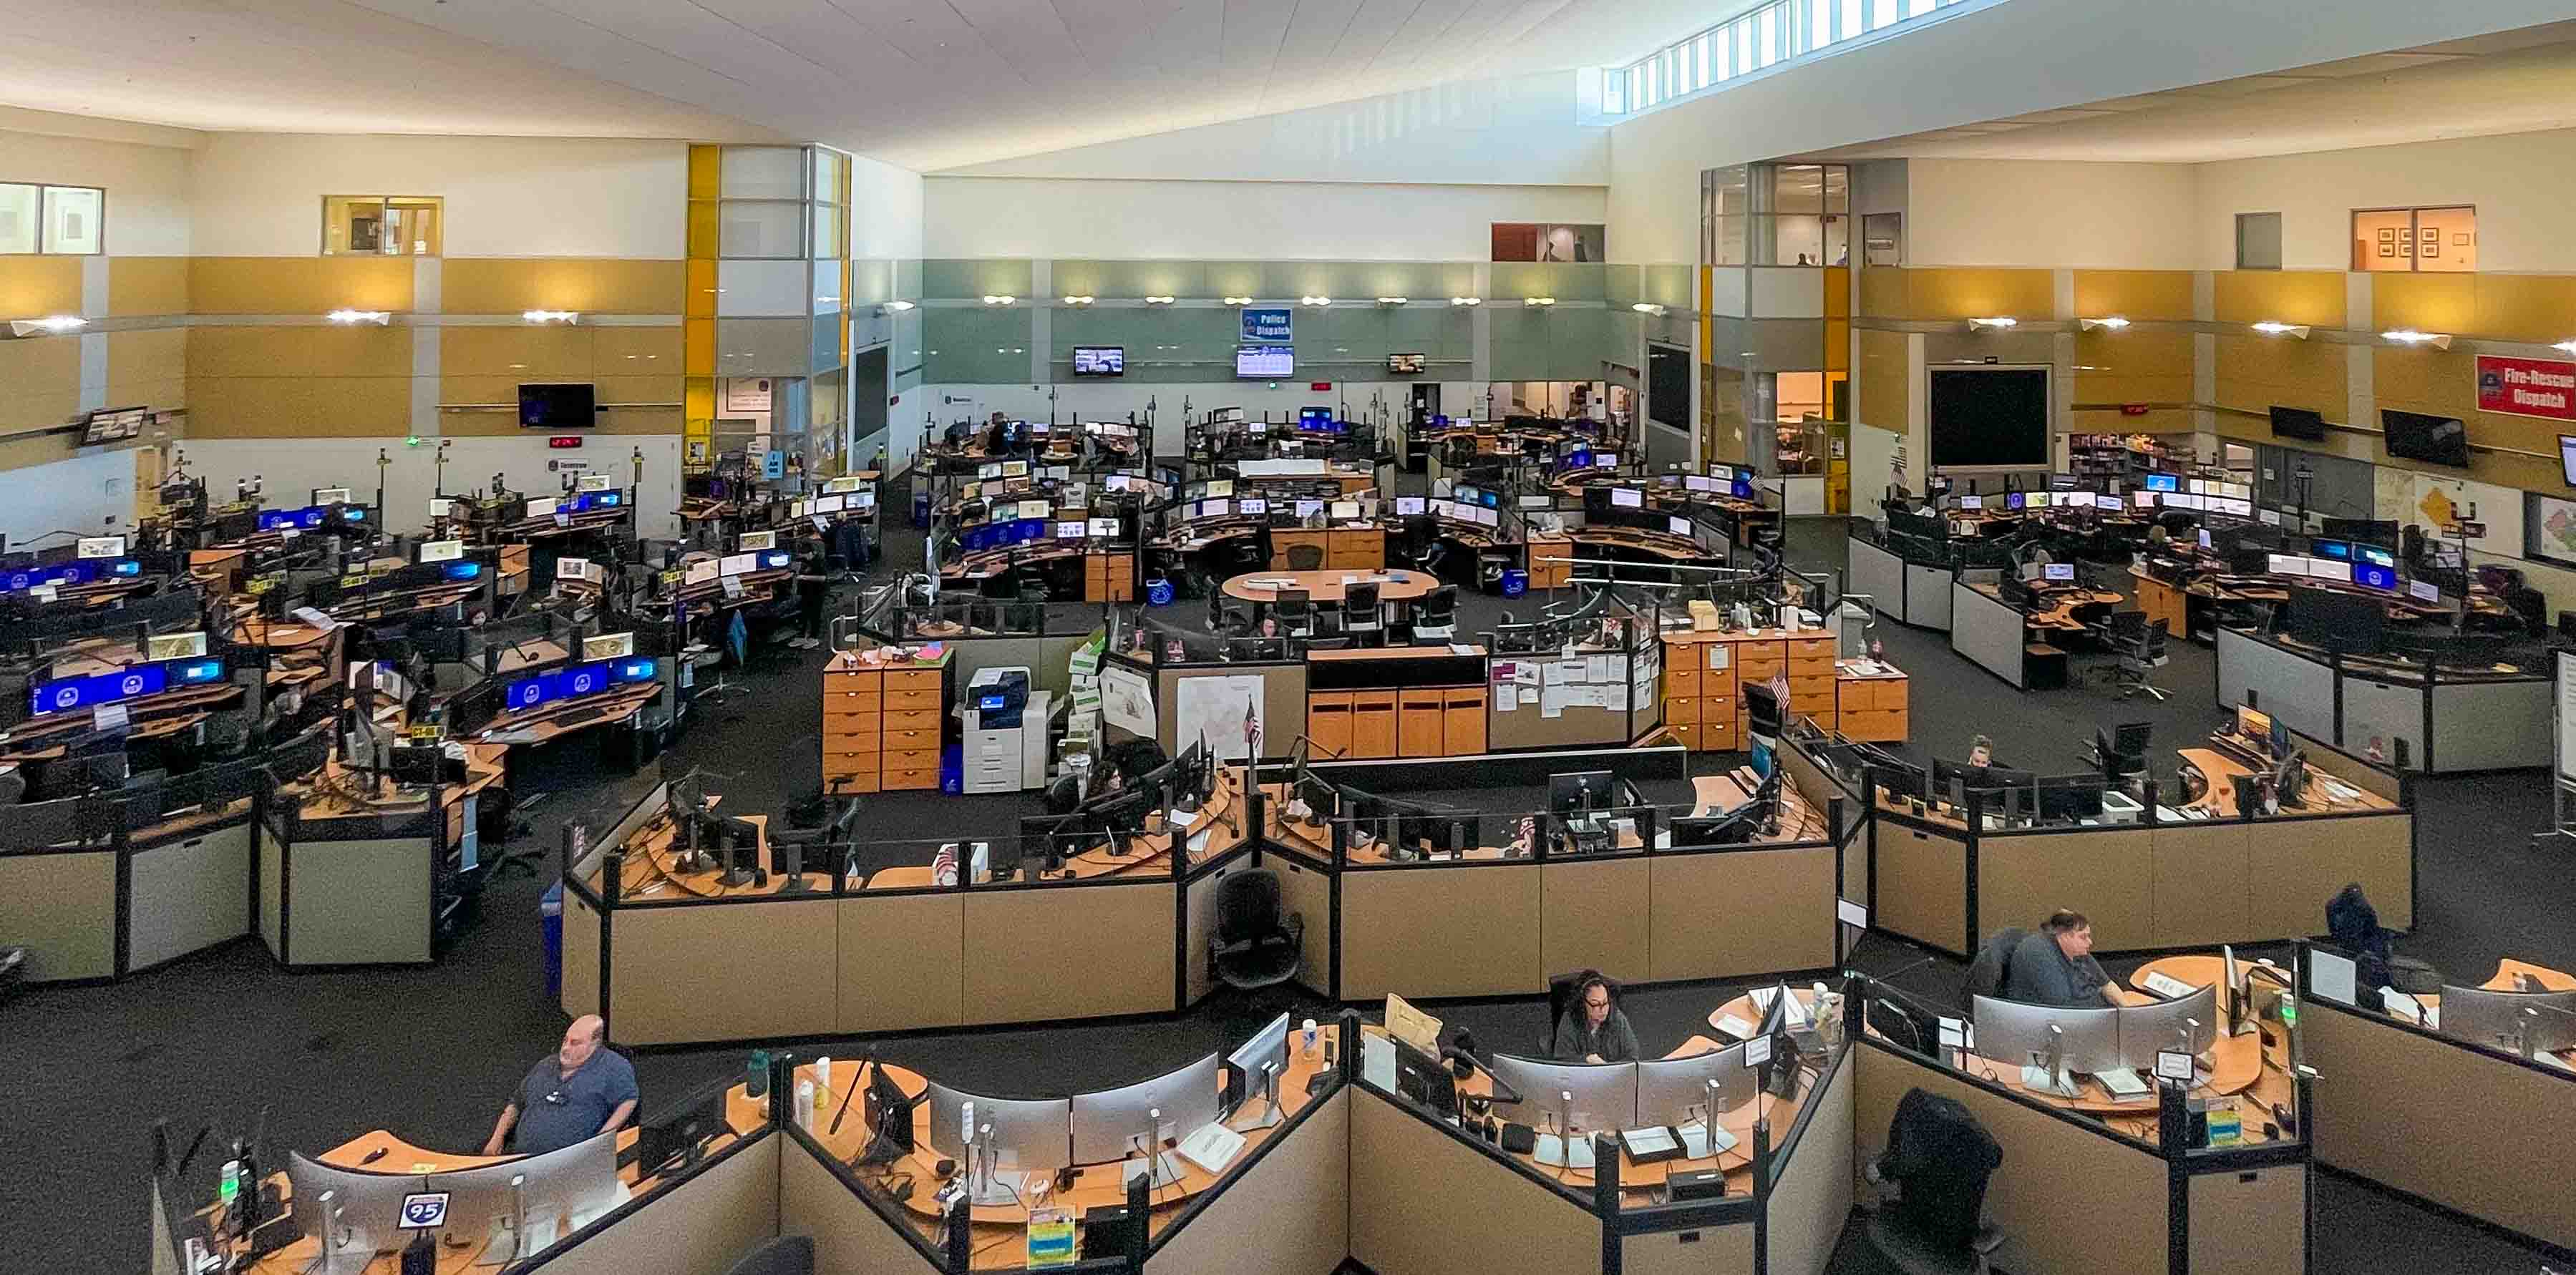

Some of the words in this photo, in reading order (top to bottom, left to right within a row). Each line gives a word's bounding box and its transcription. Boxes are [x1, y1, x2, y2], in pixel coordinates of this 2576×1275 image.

[1261, 315, 1285, 323] Police
[1257, 326, 1289, 336] Dispatch
[2504, 367, 2575, 388] Fire-Rescue
[2514, 389, 2565, 408] Dispatch
[411, 1204, 439, 1218] 95
